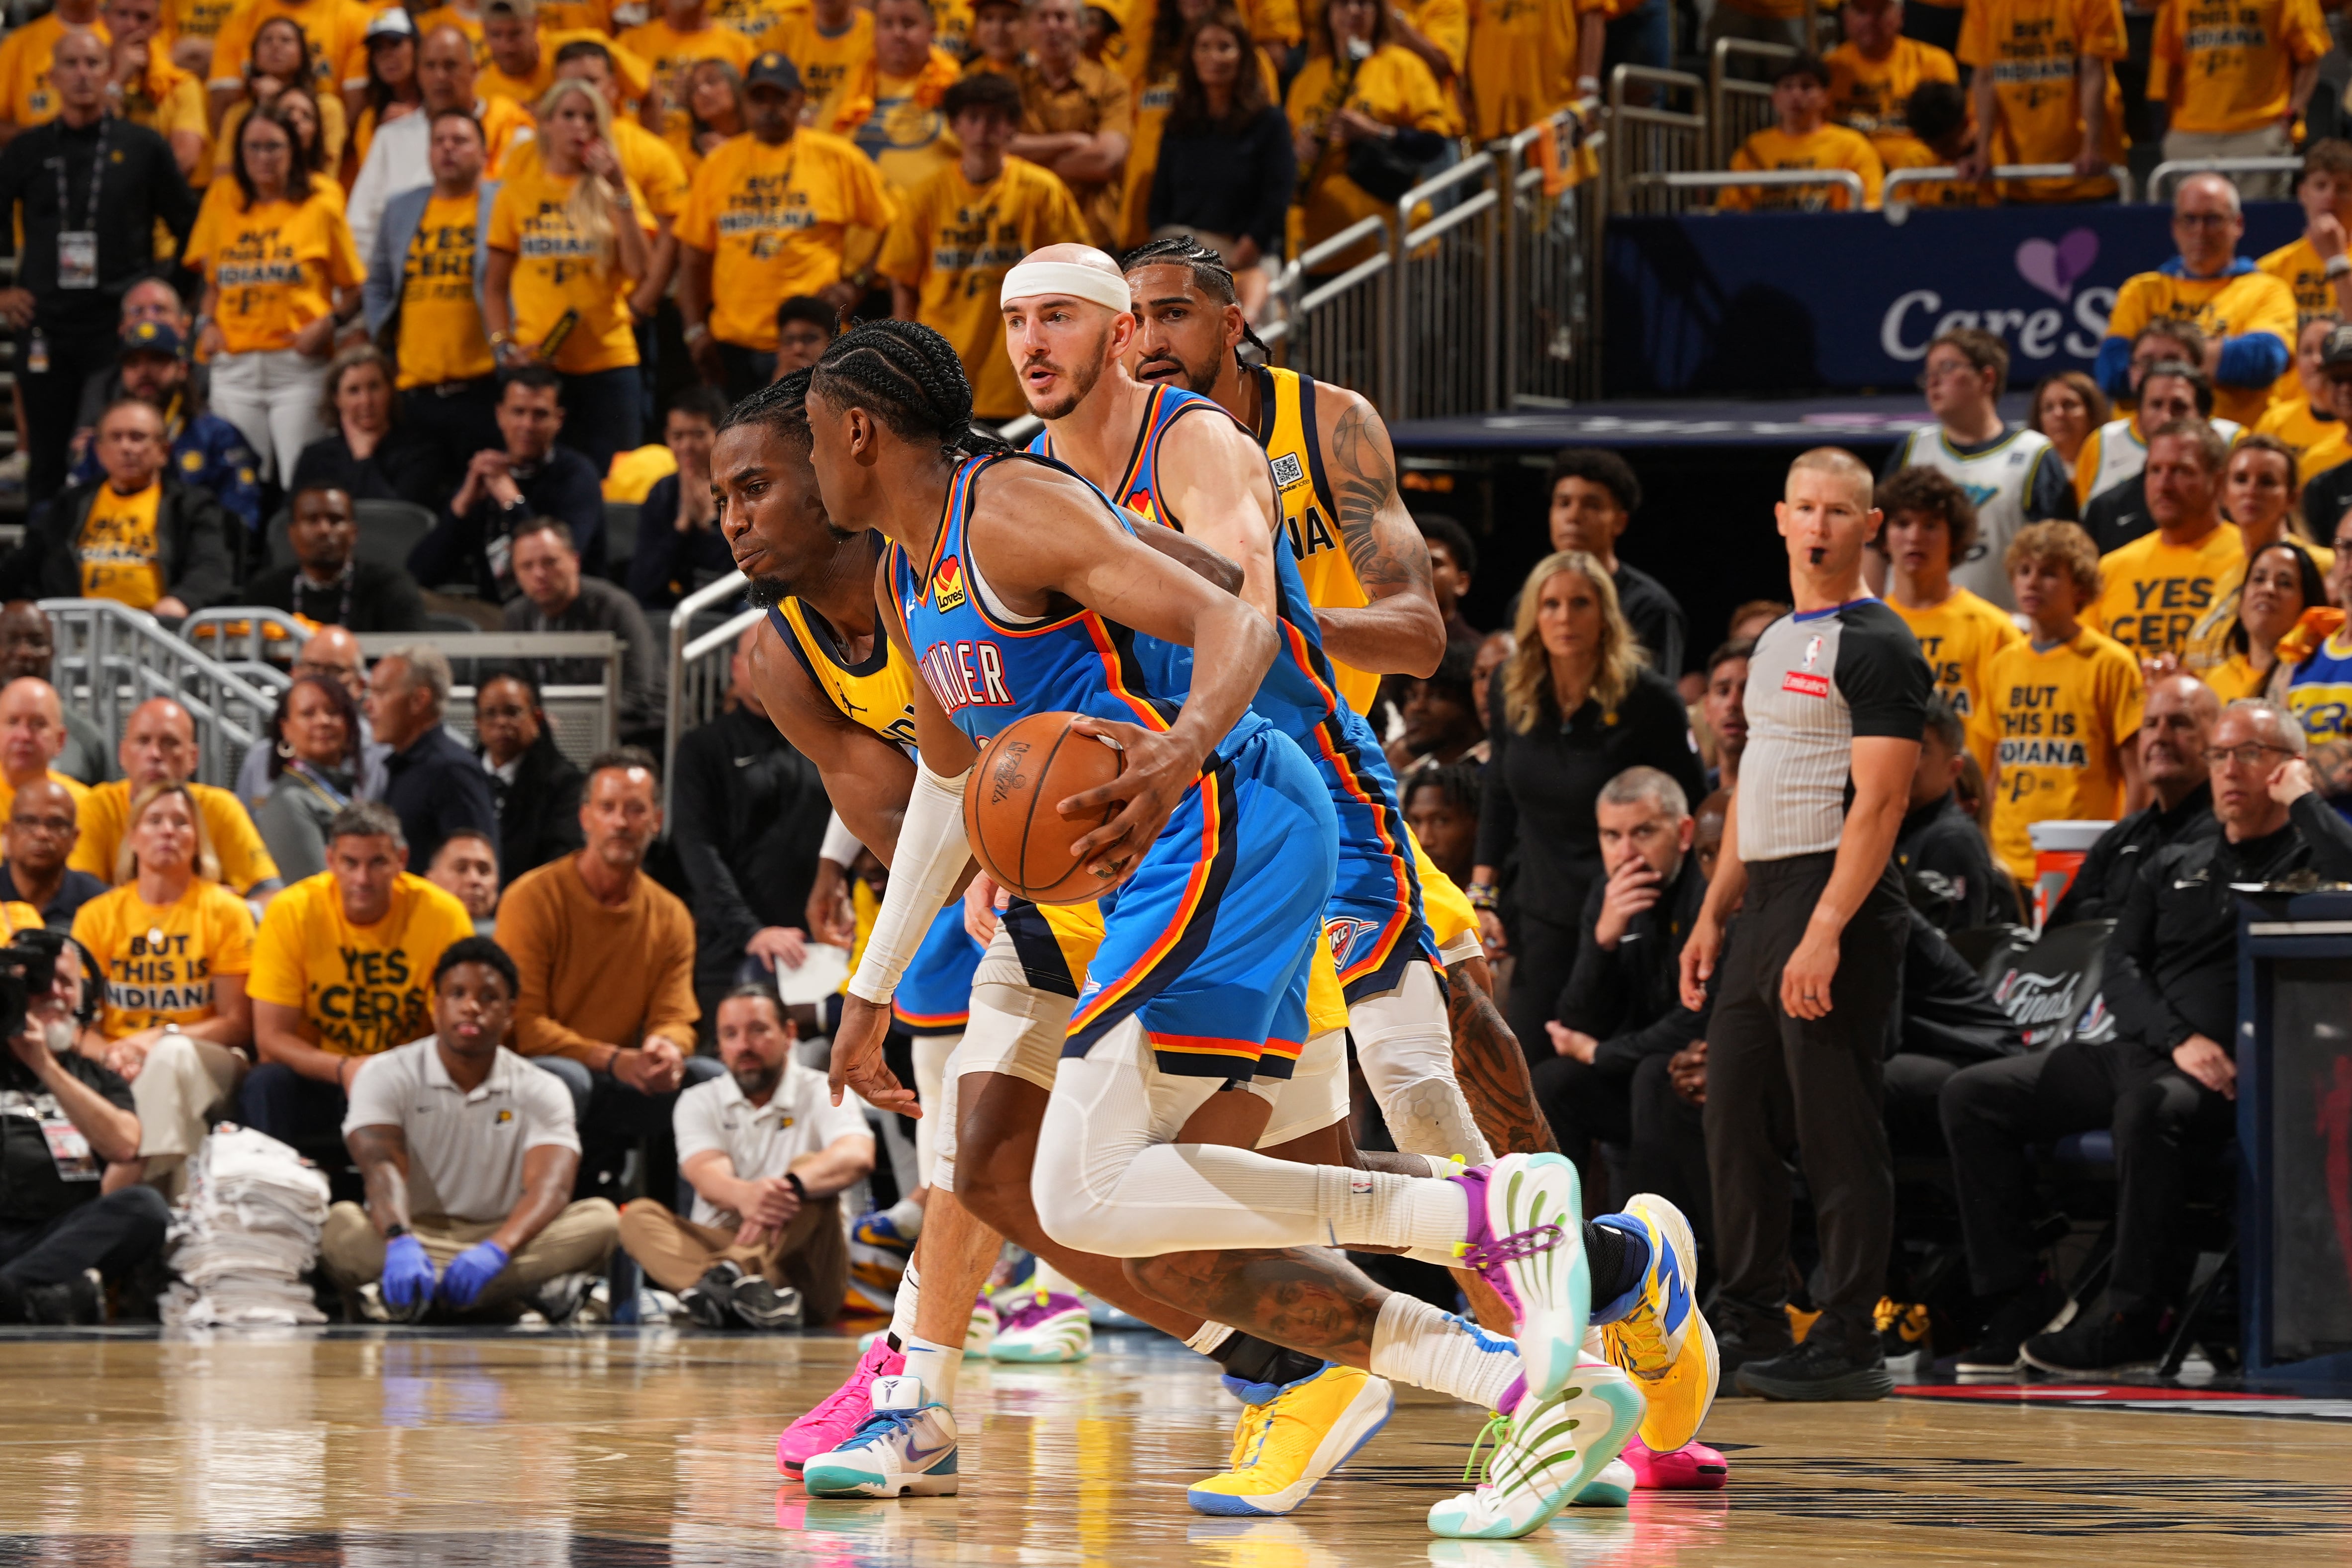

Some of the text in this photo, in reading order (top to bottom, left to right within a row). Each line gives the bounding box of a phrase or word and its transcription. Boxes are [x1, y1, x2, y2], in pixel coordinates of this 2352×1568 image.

[2134, 578, 2214, 610] YES
[2010, 685, 2059, 708] BUT
[2053, 713, 2076, 735] IS
[130, 934, 189, 957] BUT
[111, 957, 209, 982] THIS IS
[340, 946, 409, 985] YES
[2005, 971, 2081, 1026] Finals
